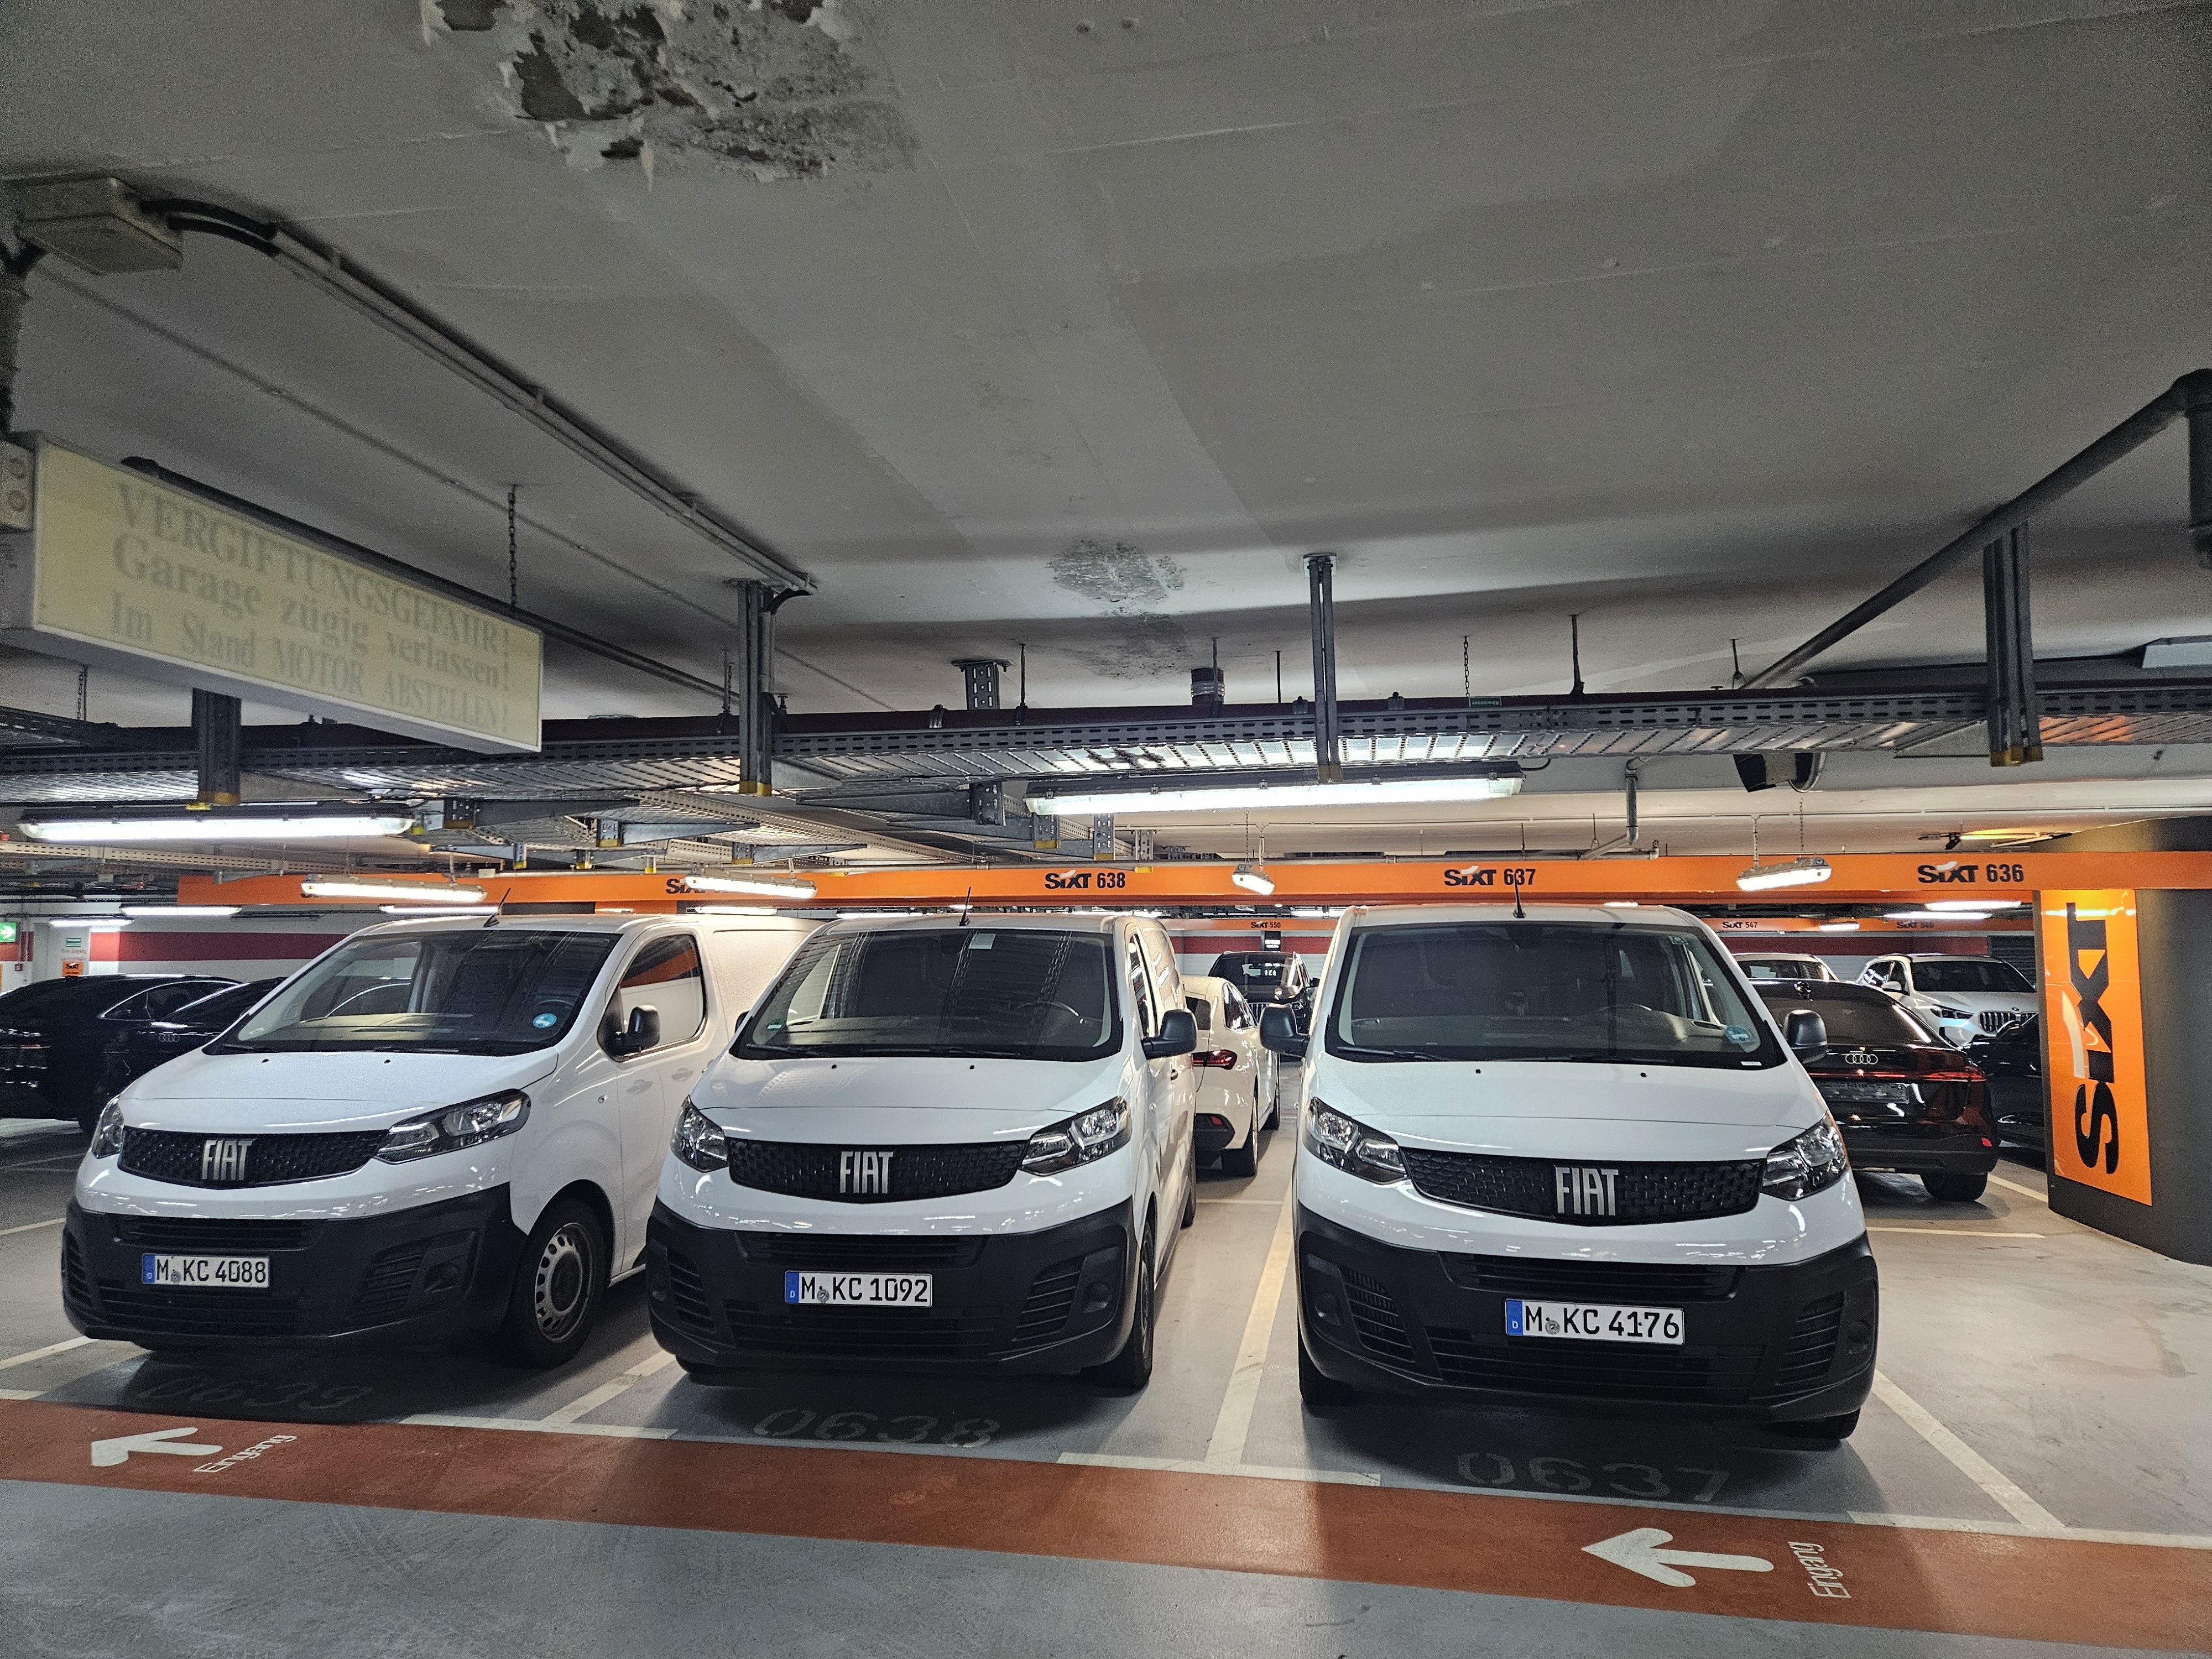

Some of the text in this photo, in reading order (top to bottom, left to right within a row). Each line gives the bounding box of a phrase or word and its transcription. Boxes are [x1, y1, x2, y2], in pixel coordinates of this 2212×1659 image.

[117, 481, 510, 659] VERGIFTUNGSGEFAHR!
[112, 533, 510, 691] Garage zügig verlassen!
[111, 590, 510, 734] Im Stand MOTOR ABSTELLEN!
[1044, 869, 1126, 889] SIXT 638
[1444, 865, 1536, 886] SIXT 637
[1917, 861, 2025, 884] SIXT 636
[1251, 920, 1269, 928] SIXT
[1722, 920, 1743, 928] SIXT
[2062, 902, 2120, 1175] SIXT
[201, 1139, 253, 1181] FIAT
[839, 1151, 894, 1194] FIAT
[1554, 1166, 1619, 1216] FIAT
[156, 1259, 169, 1281] M
[183, 1259, 210, 1282] KC
[215, 1260, 267, 1284] 4088
[801, 1276, 815, 1300] M
[833, 1276, 863, 1301] KC
[869, 1278, 928, 1303] 1092
[1525, 1305, 1542, 1332] M
[1563, 1307, 1600, 1334] KC
[1609, 1310, 1680, 1339] 4176
[753, 1407, 1000, 1448] 0638
[192, 1434, 298, 1473] Eingang
[1457, 1452, 1729, 1503] 0637
[1787, 1541, 1851, 1598] Eingang
